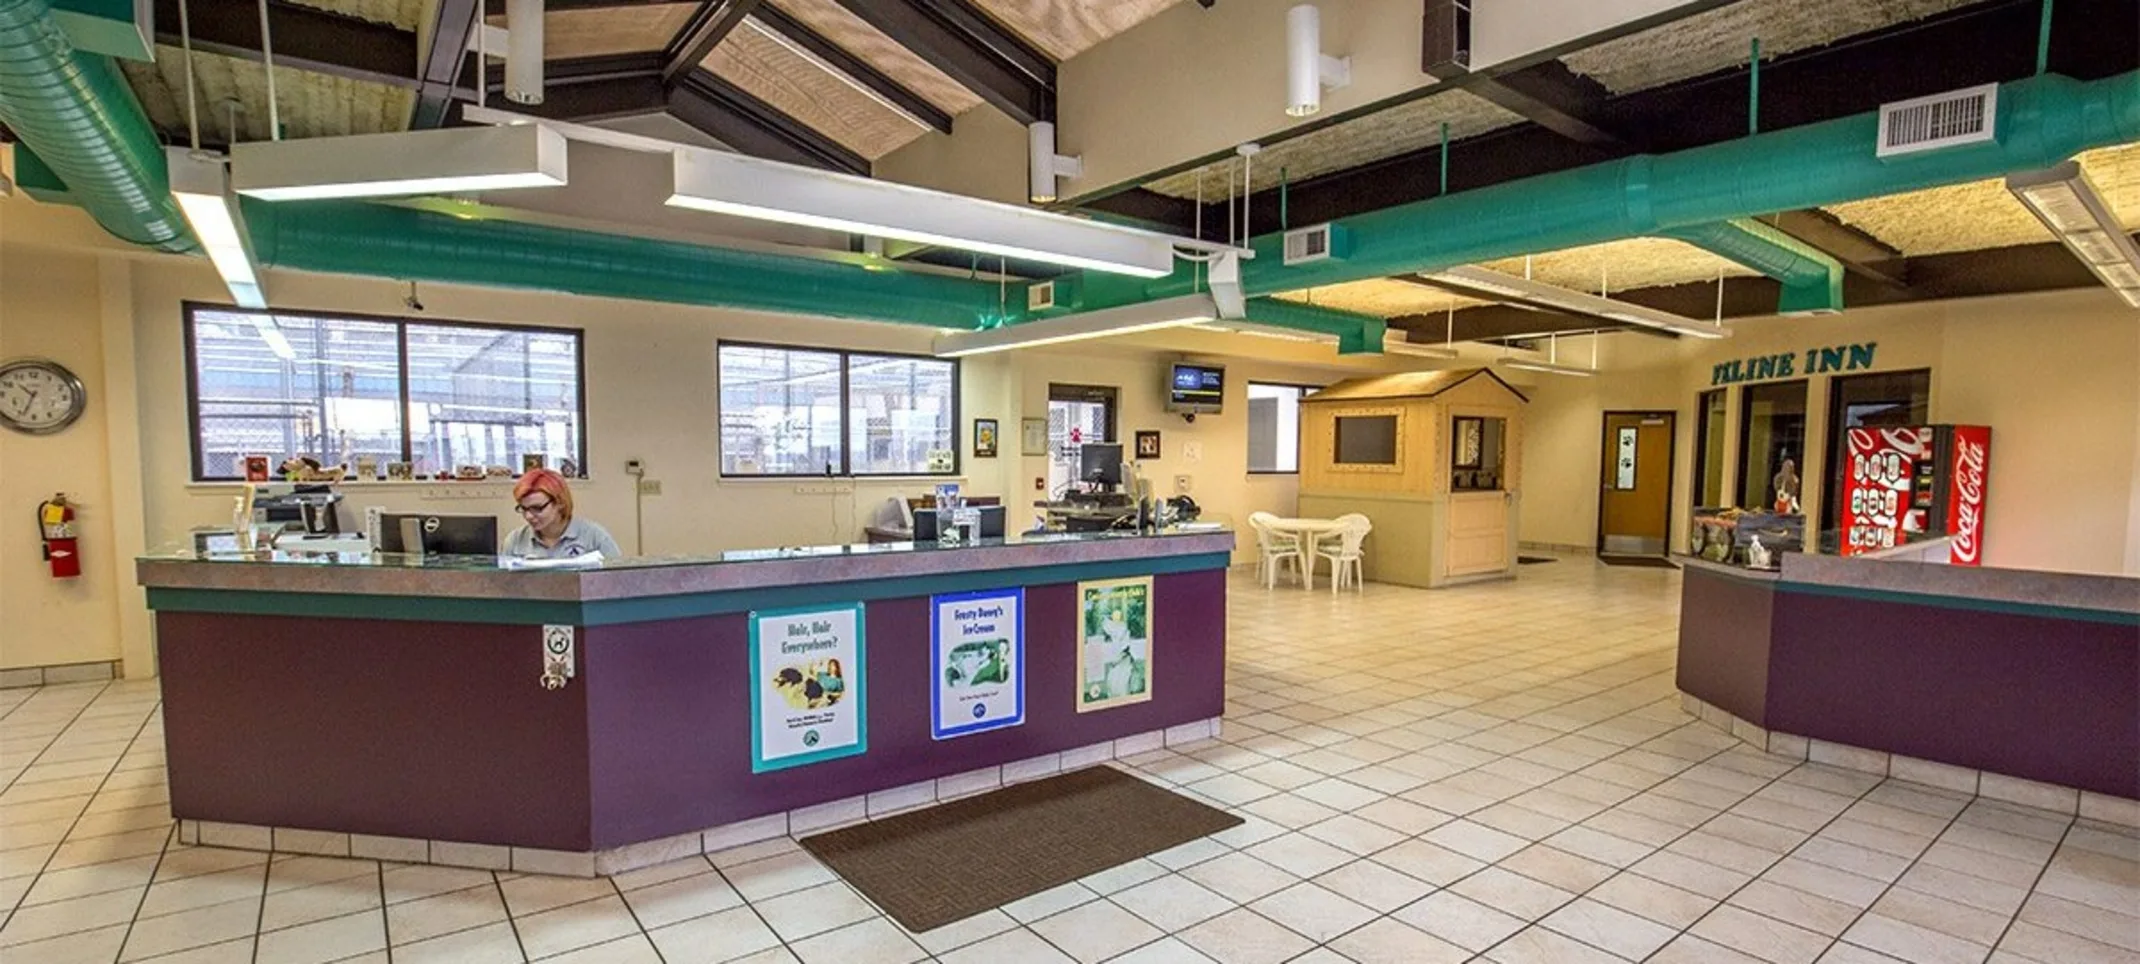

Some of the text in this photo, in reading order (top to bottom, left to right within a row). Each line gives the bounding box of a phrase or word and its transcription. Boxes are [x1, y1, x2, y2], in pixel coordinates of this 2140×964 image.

[1711, 341, 1877, 386] FELINE INN
[781, 635, 838, 654] Everywhere?
